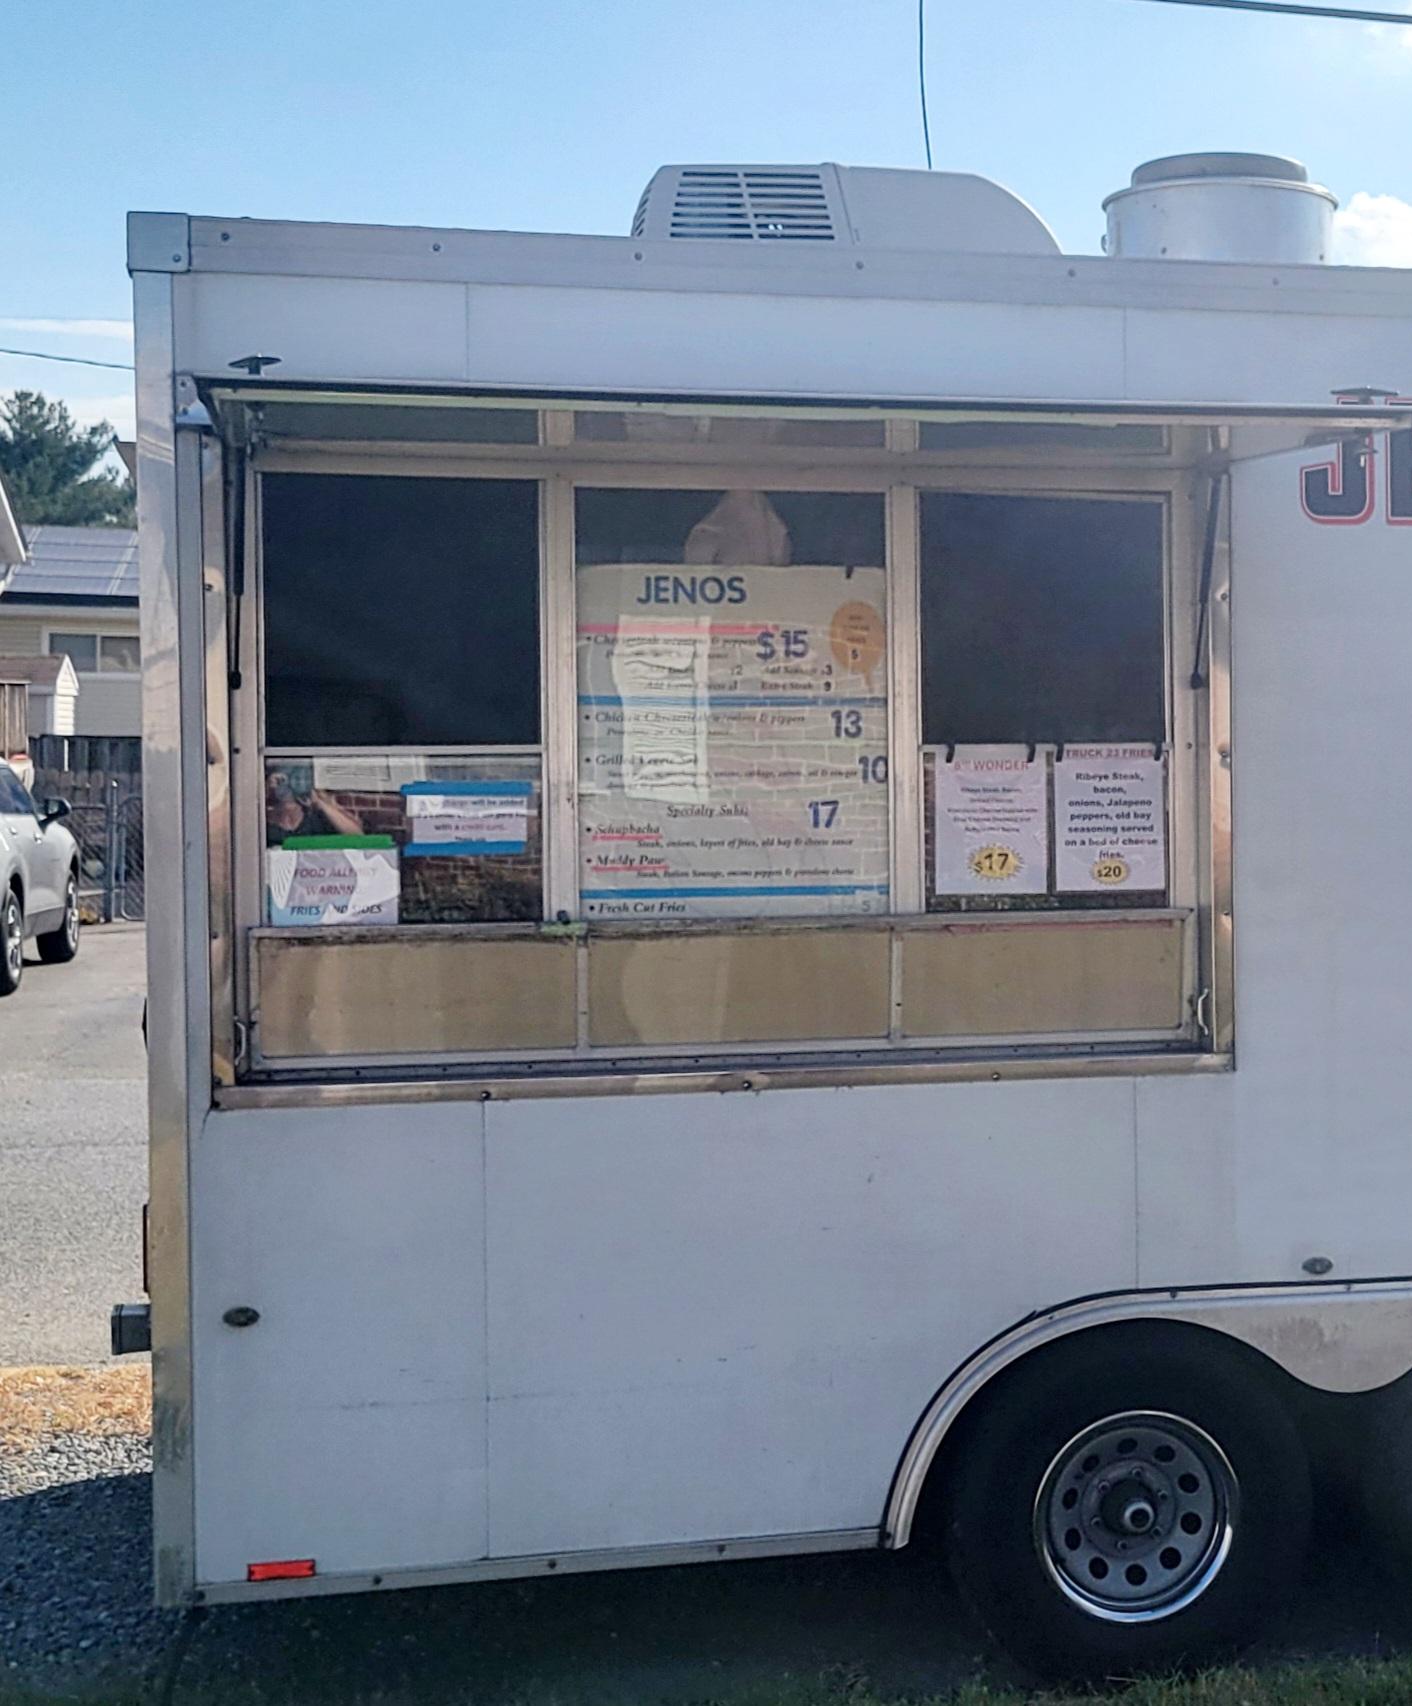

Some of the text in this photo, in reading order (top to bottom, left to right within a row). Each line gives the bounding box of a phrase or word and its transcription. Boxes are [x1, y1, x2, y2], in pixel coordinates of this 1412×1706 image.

[636, 576, 748, 604] JENOS
[755, 628, 808, 662] $15
[831, 709, 863, 738] 13
[1066, 748, 1103, 758] TRUCK
[858, 755, 888, 784] 10
[973, 759, 1029, 771] WONDER
[1075, 771, 1144, 782] Ribeye Steak,
[1093, 786, 1127, 795] bacon,
[1068, 798, 1153, 808] onions, Jalapeno
[666, 804, 715, 818] Specialty
[808, 800, 839, 829] 17
[1070, 811, 1151, 822] peppers, old bay
[1067, 824, 1154, 835] seasoning served
[1064, 839, 1077, 847] on
[1088, 838, 1107, 846] bed
[1109, 837, 1119, 845] of
[1121, 837, 1158, 846] cheese
[305, 883, 356, 896] WARNIN
[290, 904, 321, 916] FRIES
[598, 902, 686, 913] Fresh Cut Fries
